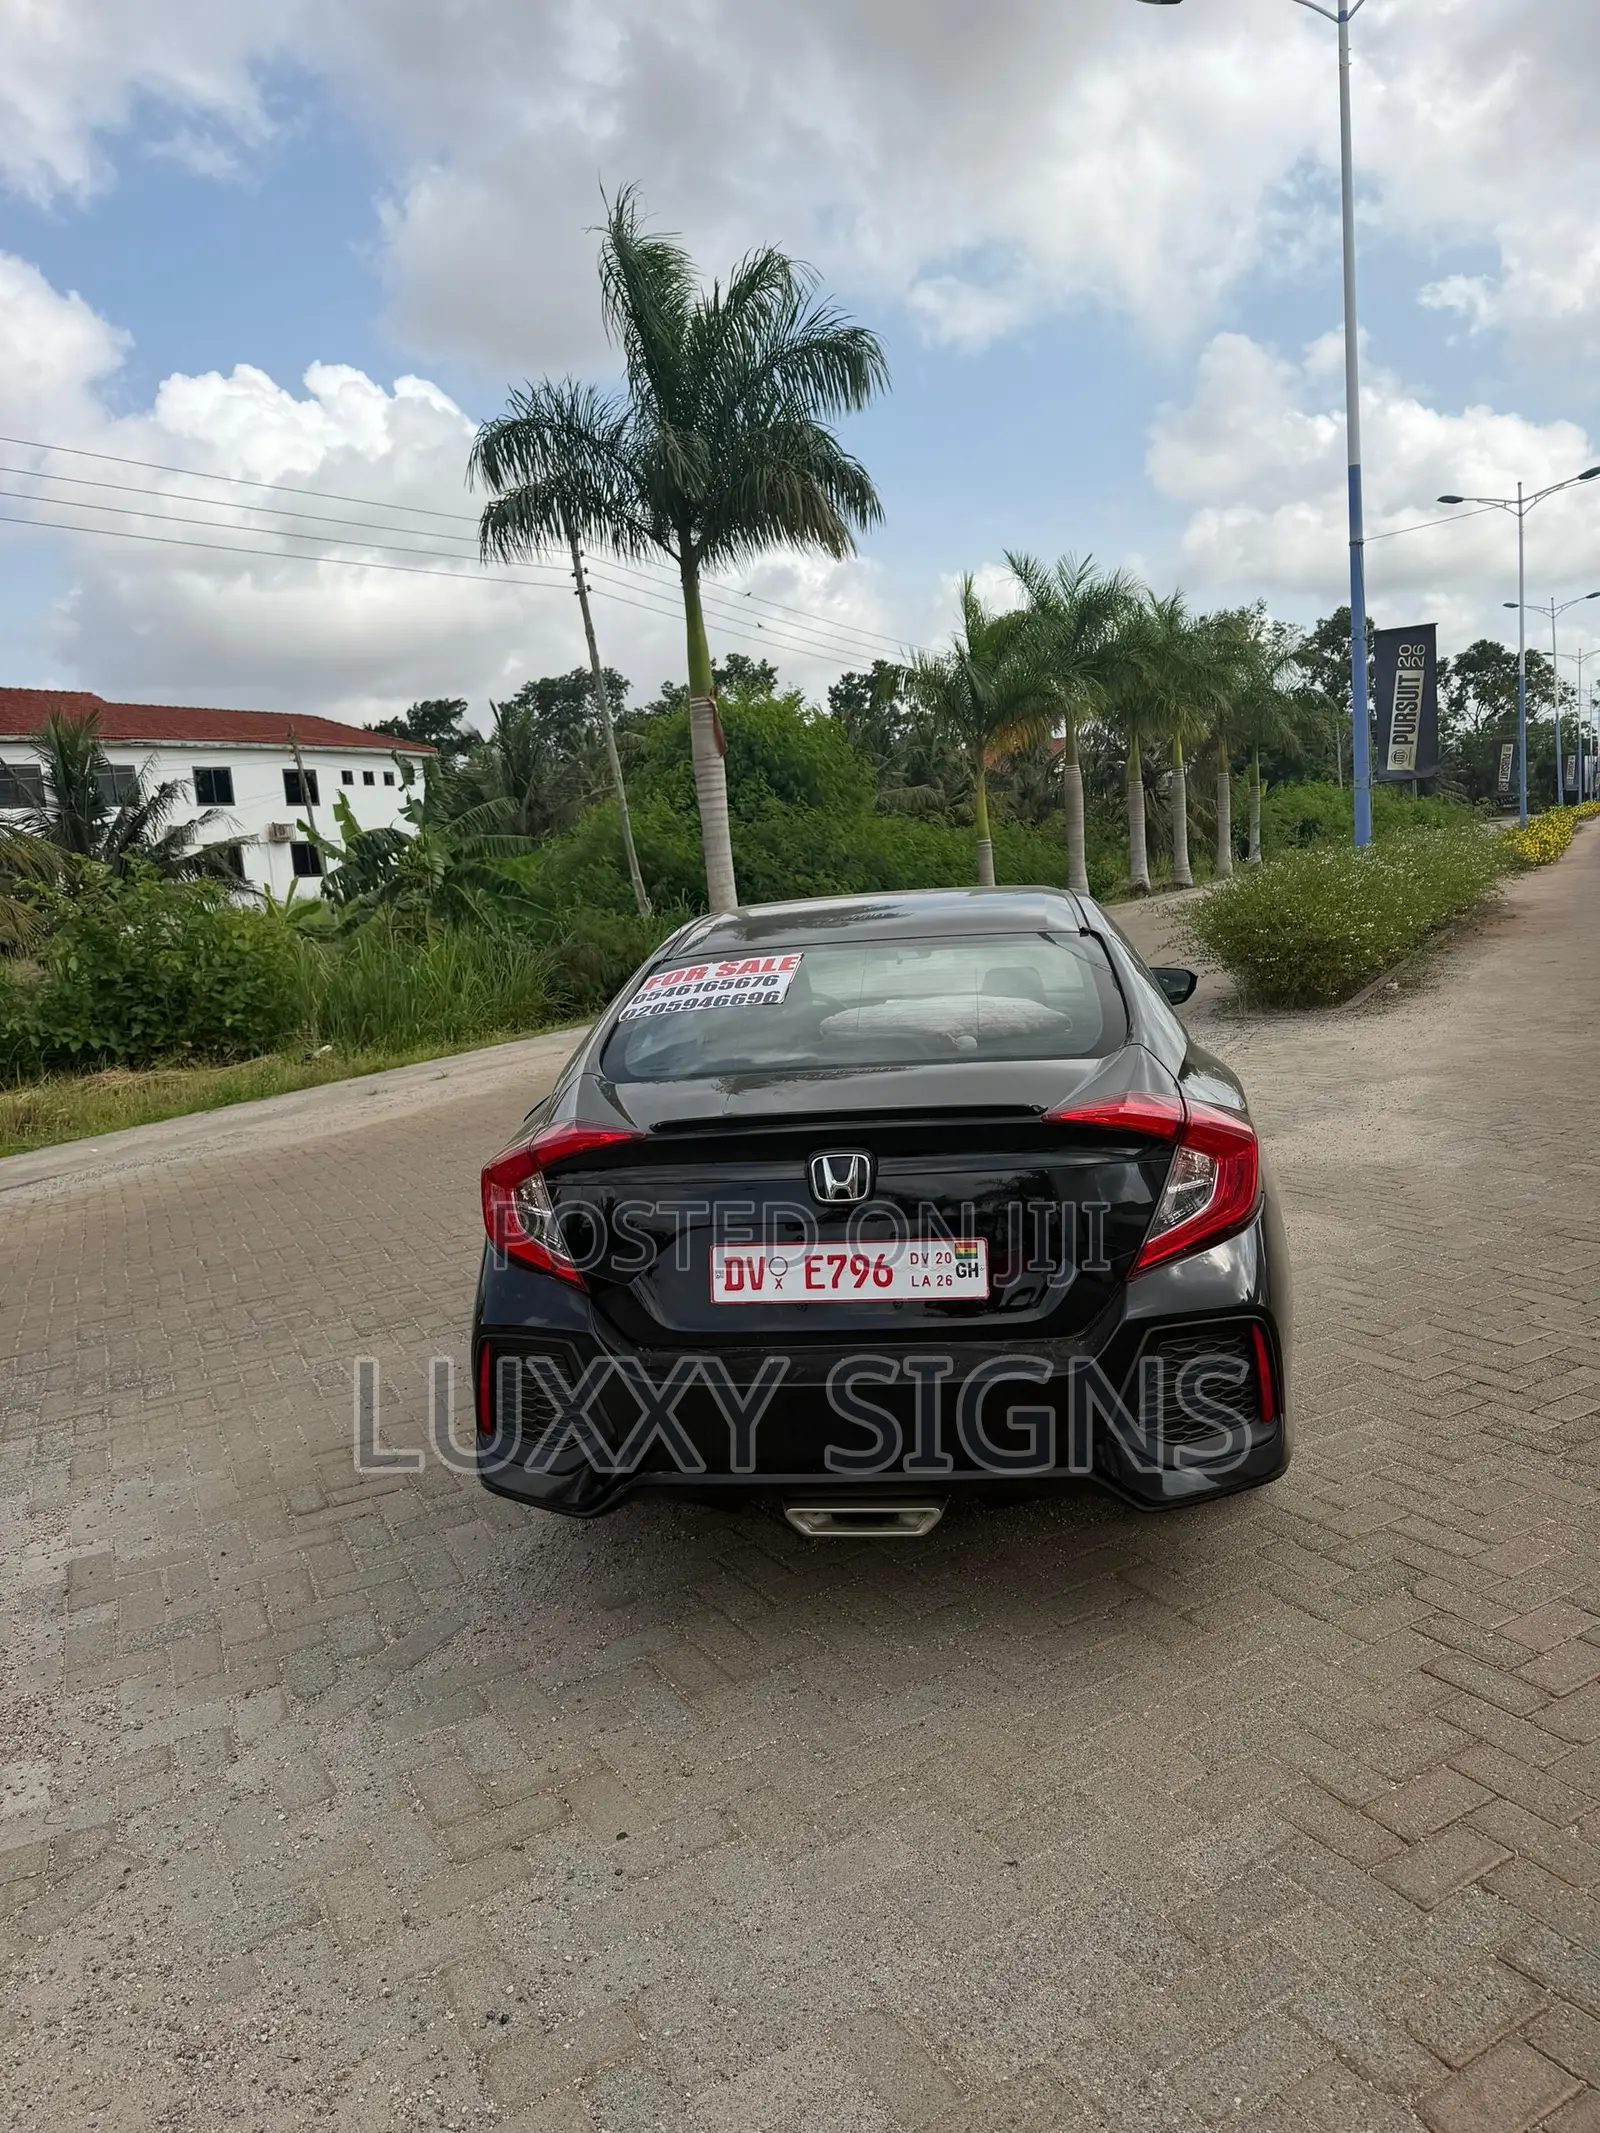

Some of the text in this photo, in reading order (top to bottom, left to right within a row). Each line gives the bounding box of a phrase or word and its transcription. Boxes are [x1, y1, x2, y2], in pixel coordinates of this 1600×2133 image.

[1397, 643, 1412, 668] 20
[1411, 643, 1426, 668] 26
[1392, 674, 1421, 745] PURSUIT
[643, 956, 797, 991] FOR SALE
[631, 974, 780, 1005] 0546165676
[620, 990, 781, 1020] 0205946696
[724, 1253, 894, 1290] DV E796
[910, 1252, 952, 1265] DV 20
[955, 1262, 979, 1278] GH
[911, 1274, 953, 1287] LA 26
